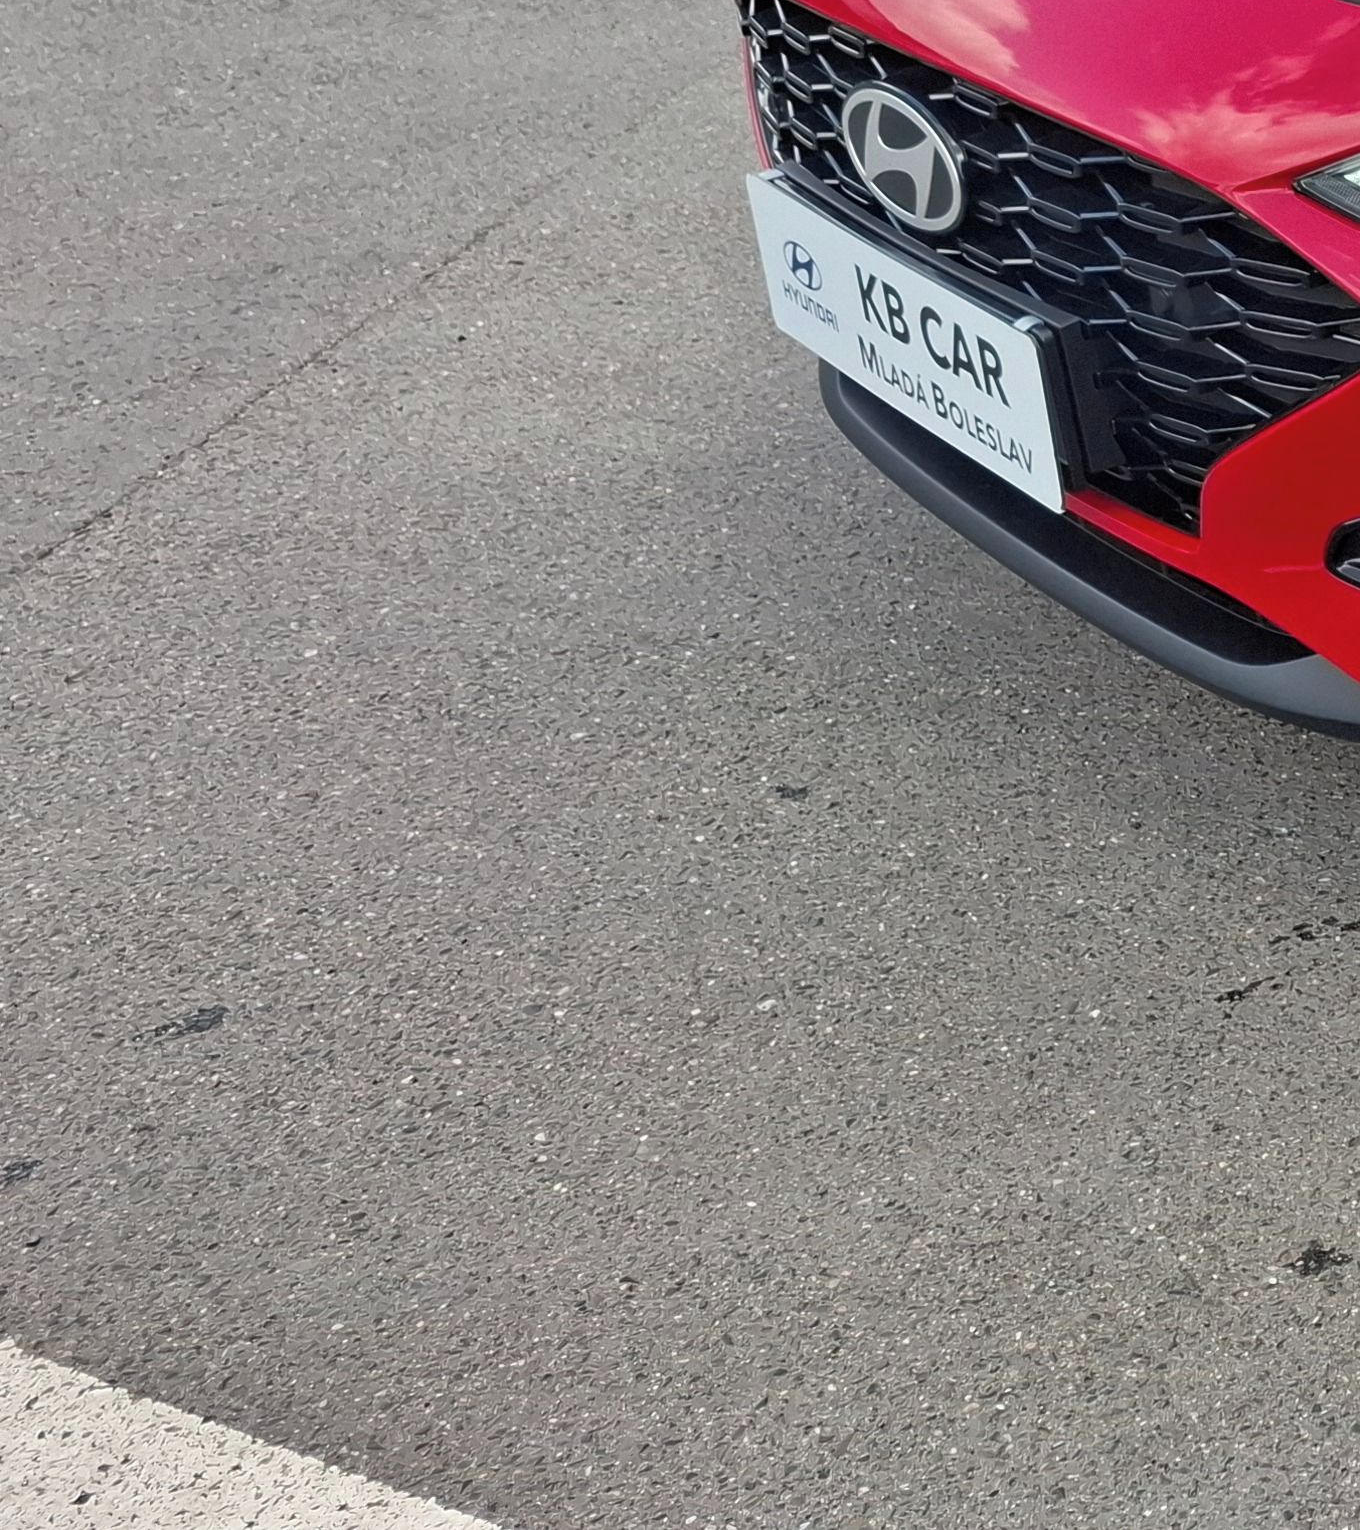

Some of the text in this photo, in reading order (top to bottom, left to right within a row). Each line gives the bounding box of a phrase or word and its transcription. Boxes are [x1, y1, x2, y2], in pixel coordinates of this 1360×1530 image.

[782, 279, 840, 334] HYUNDAI
[854, 263, 1012, 409] KB CAR
[931, 381, 1033, 474] BOLESLAV
